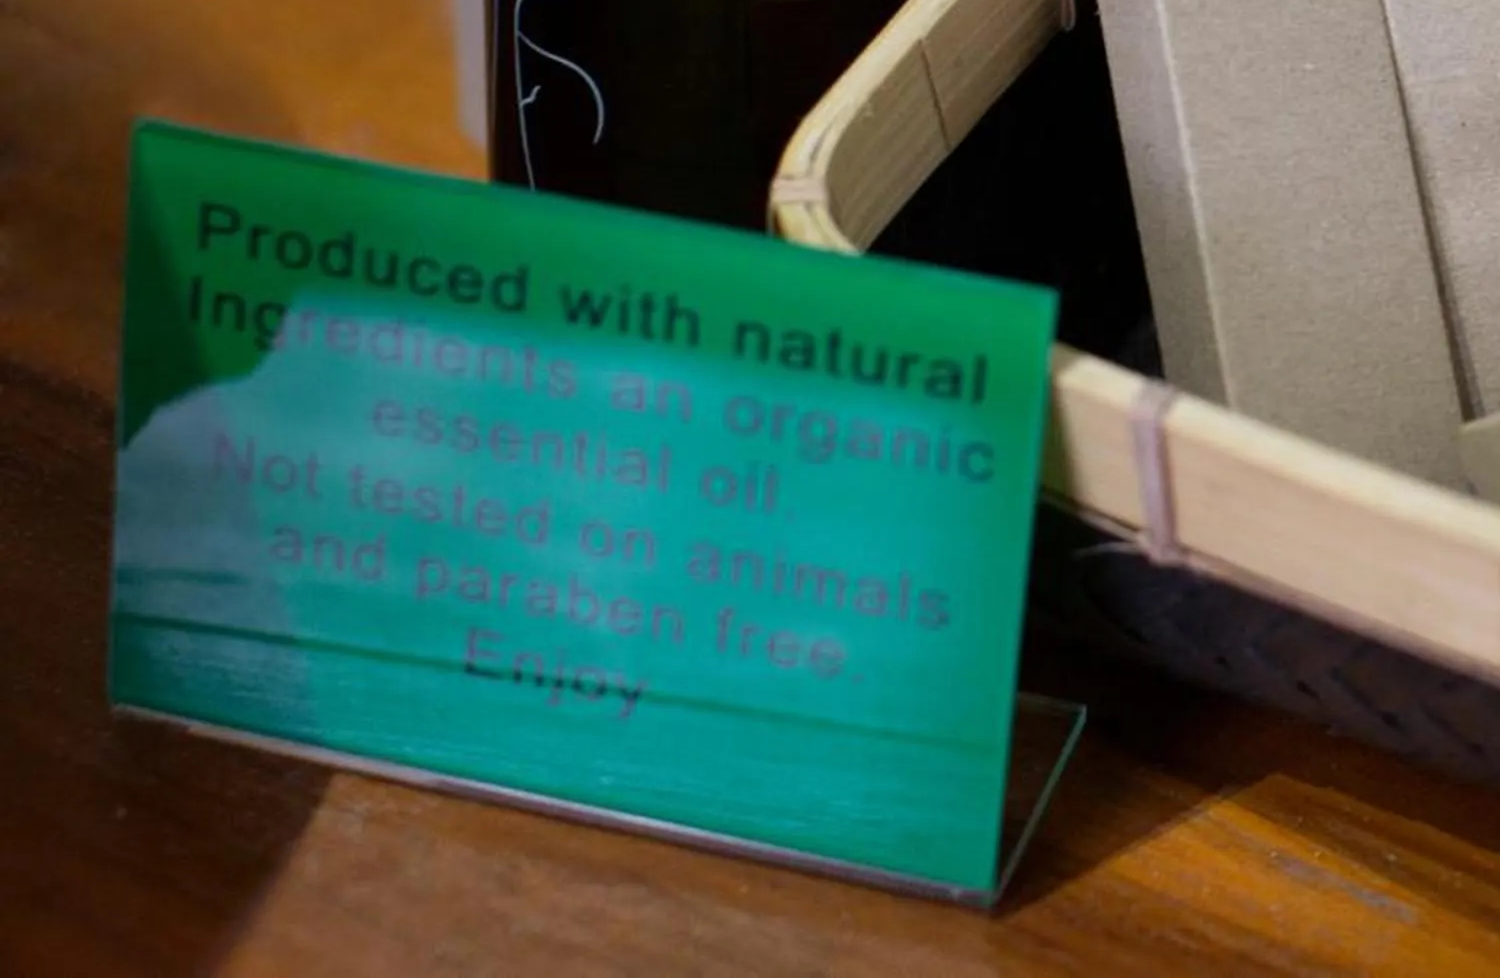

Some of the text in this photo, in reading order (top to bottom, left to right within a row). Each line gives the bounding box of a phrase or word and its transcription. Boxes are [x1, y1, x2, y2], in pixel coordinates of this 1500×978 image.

[189, 276, 996, 482] Ingredients an organic
[198, 202, 988, 405] Produced with natural
[212, 432, 950, 630] Not tested on animals
[372, 398, 672, 493] essential
[268, 524, 866, 684] and paraben free.
[463, 625, 648, 720] Enjoy
